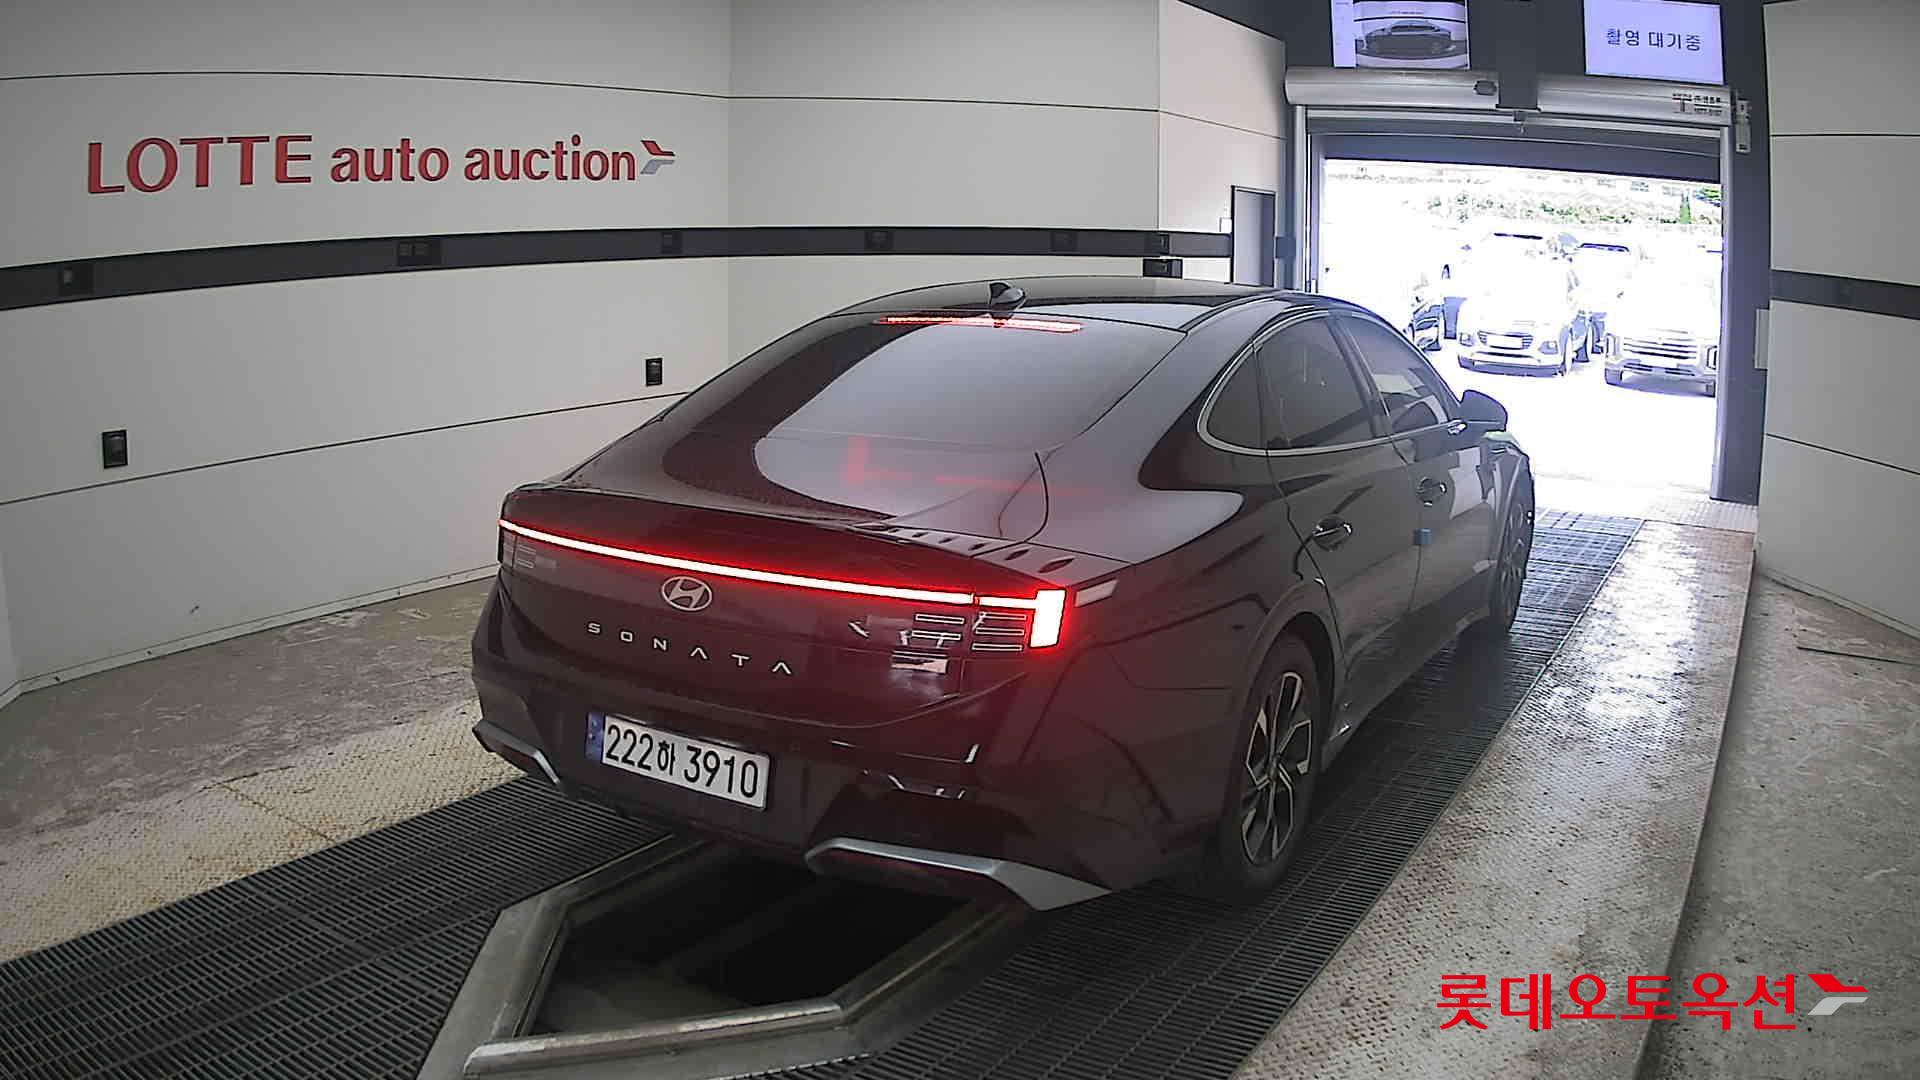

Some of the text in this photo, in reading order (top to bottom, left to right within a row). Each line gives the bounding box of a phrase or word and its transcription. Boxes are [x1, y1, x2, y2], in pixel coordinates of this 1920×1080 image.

[88, 133, 637, 194] LOTTE auto auction
[587, 621, 792, 675] SONATA
[604, 723, 759, 798] 222하 3910
